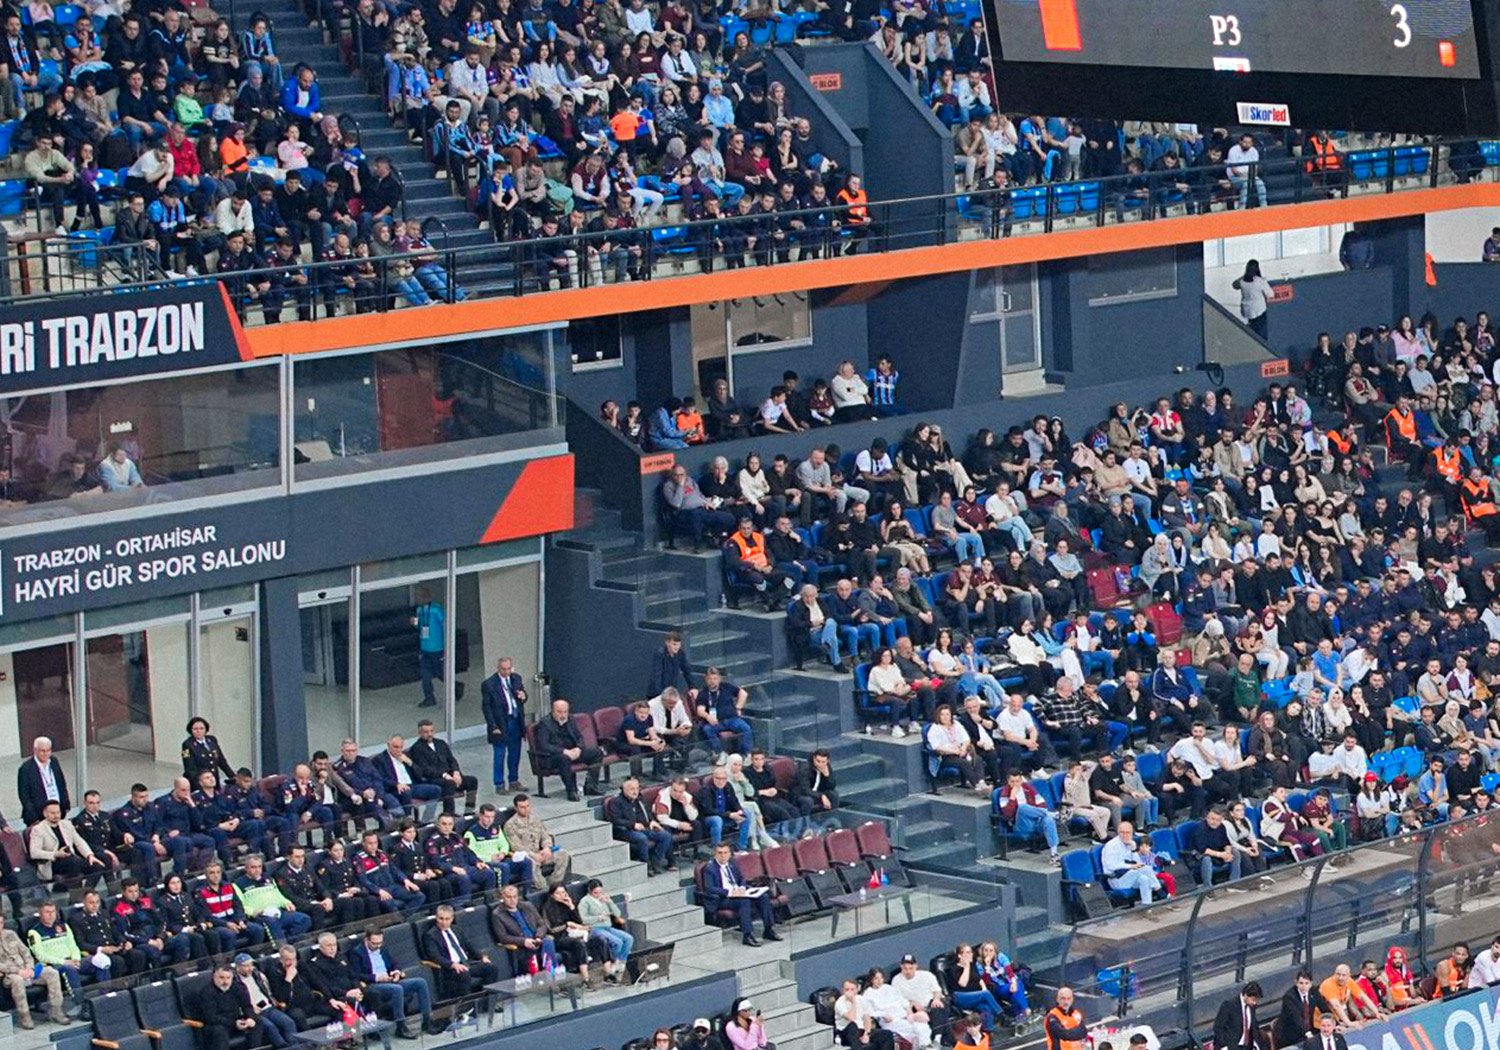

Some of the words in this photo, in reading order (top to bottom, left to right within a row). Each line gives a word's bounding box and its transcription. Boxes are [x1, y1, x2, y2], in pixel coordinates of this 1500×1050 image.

[1209, 15, 1242, 46] P3
[1390, 4, 1412, 48] 3
[1250, 106, 1287, 122] Skorled
[41, 301, 205, 369] TRABZON
[14, 544, 101, 573] TRABZON
[116, 525, 216, 558] ORTAHİSAR
[15, 568, 80, 603] HAYRİ
[85, 563, 133, 592] GÜR
[138, 554, 196, 582] SPOR
[201, 540, 286, 571] SALONU
